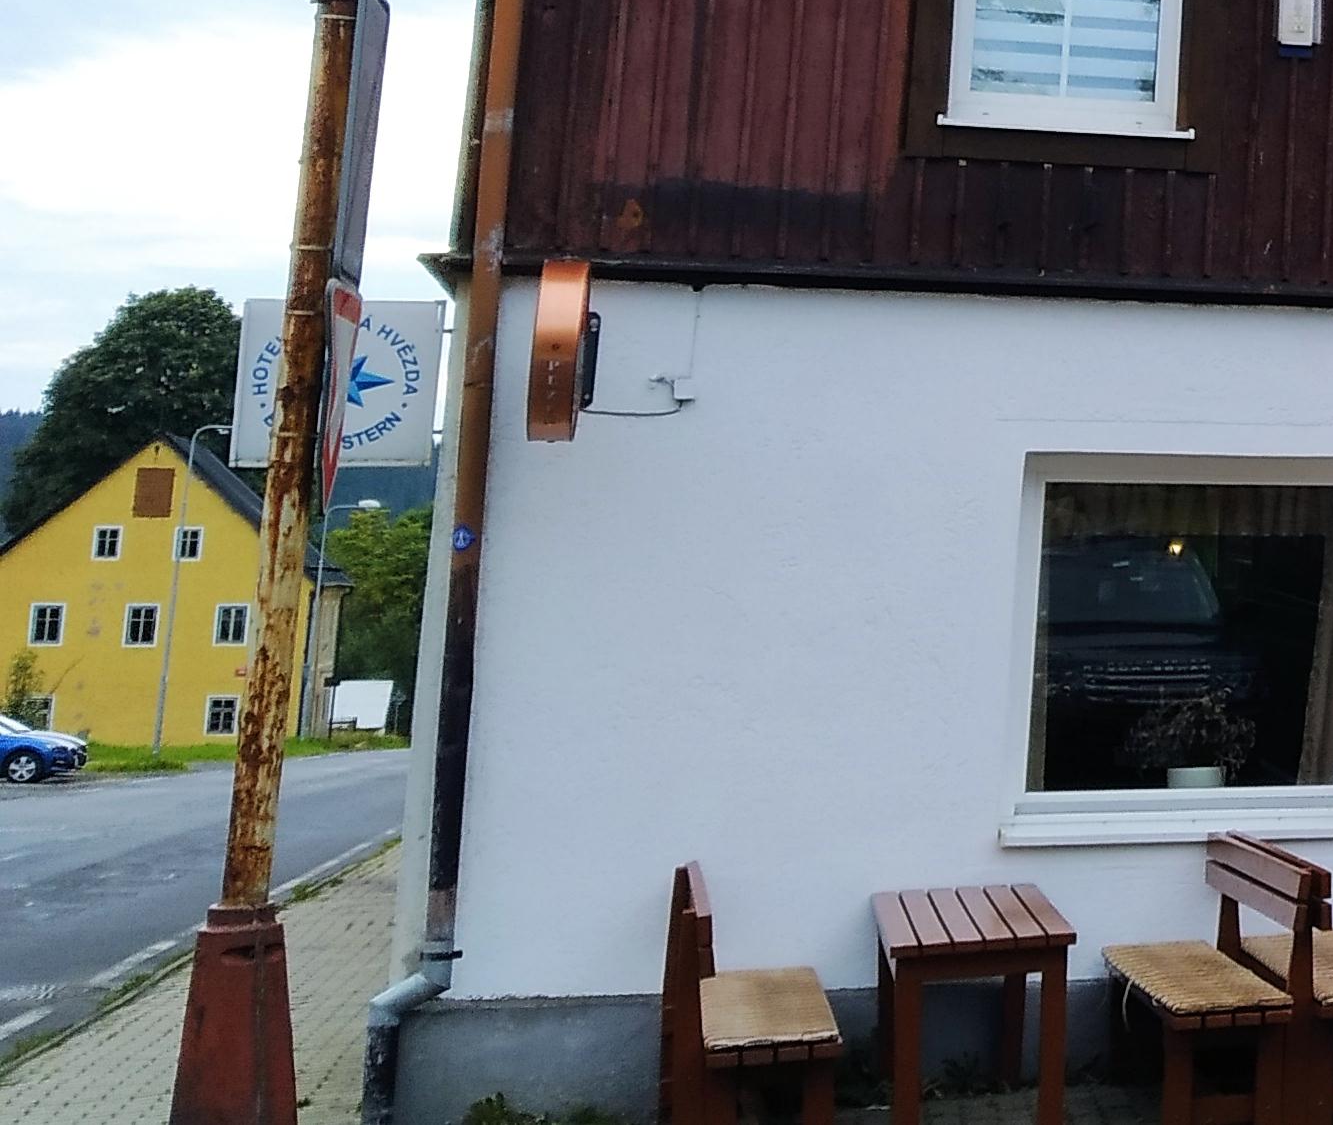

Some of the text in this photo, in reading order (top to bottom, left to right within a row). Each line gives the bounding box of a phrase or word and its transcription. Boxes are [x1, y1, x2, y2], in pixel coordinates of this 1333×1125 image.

[252, 322, 420, 397] HOTE HVĚZDA
[341, 410, 402, 451] STERN
